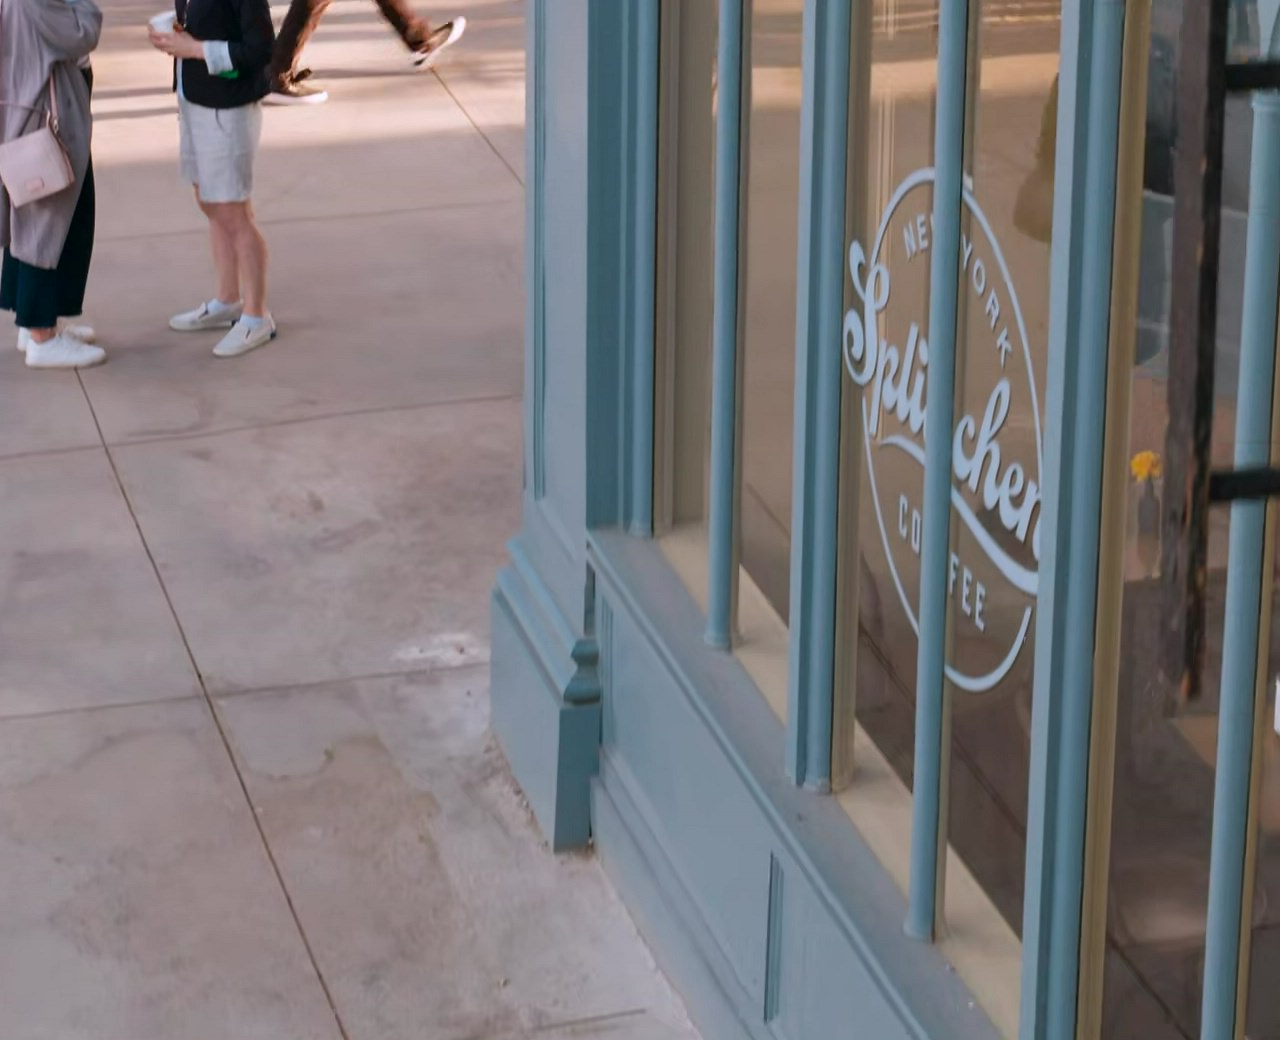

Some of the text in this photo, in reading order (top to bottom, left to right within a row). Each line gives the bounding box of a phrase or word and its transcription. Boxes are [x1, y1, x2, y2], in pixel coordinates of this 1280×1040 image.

[903, 213, 1013, 369] NE YORK
[843, 239, 1041, 562] Splichen
[898, 493, 987, 633] COFEE
